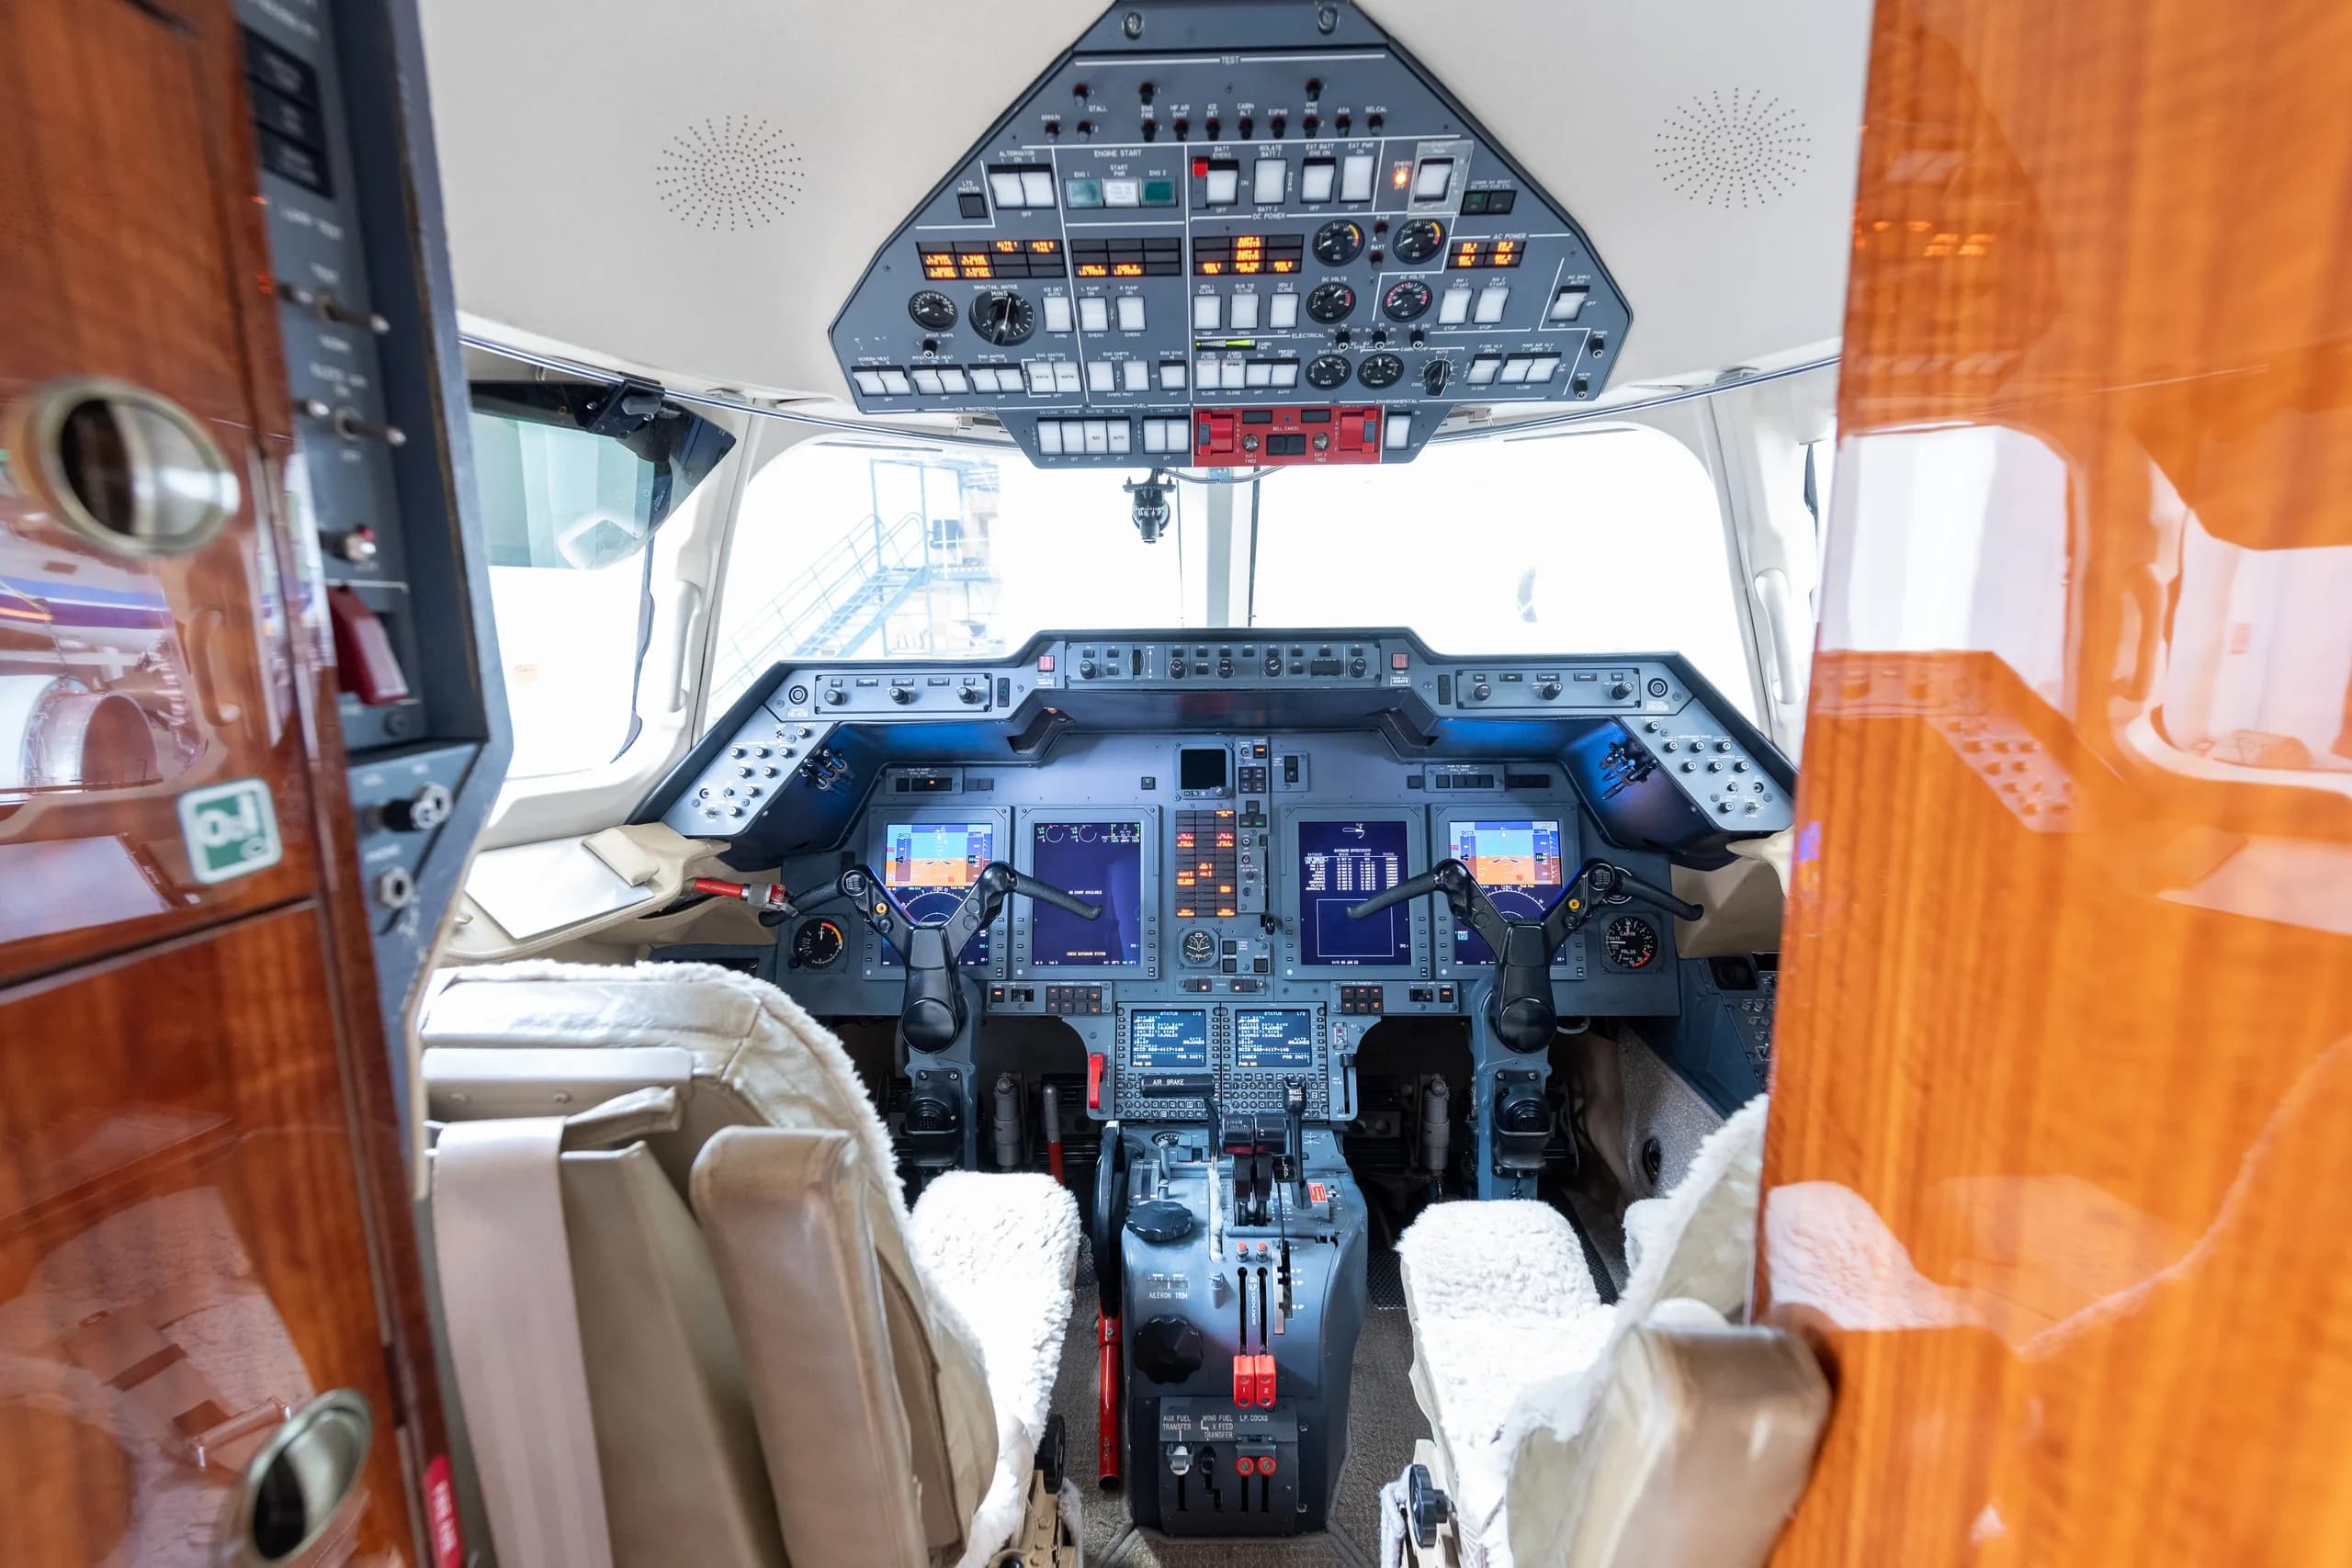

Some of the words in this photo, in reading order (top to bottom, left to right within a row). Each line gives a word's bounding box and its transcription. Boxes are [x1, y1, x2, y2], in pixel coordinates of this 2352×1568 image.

[1221, 56, 1239, 64] TEST
[1094, 150, 1117, 158] ENGINE
[1162, 1423, 1191, 1431] TRANSFER
